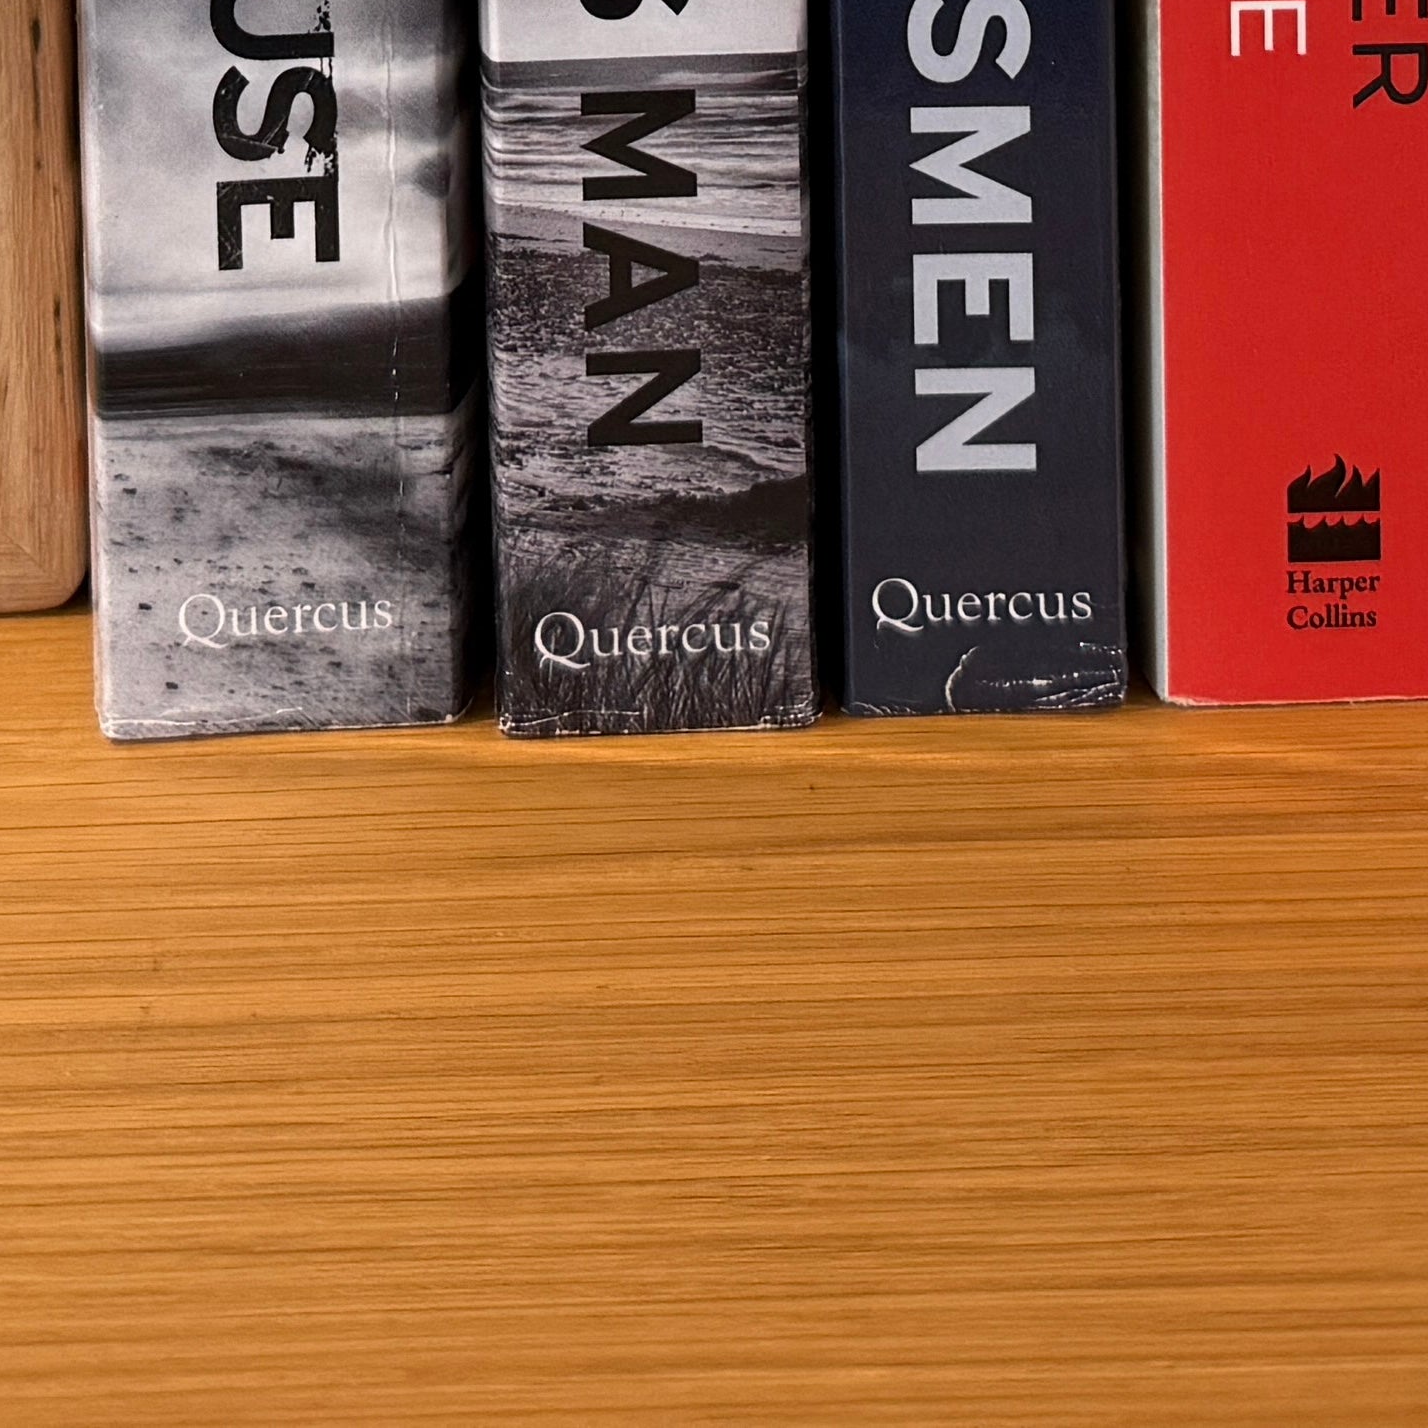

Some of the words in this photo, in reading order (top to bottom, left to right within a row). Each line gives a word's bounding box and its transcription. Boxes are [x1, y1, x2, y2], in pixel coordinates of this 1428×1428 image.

[579, 90, 703, 447] MAN
[870, 575, 1094, 636] Quercus
[1287, 570, 1380, 599] Harper
[176, 590, 396, 650] Quercus
[532, 608, 772, 672] Quercus
[1287, 605, 1377, 630] Collins
